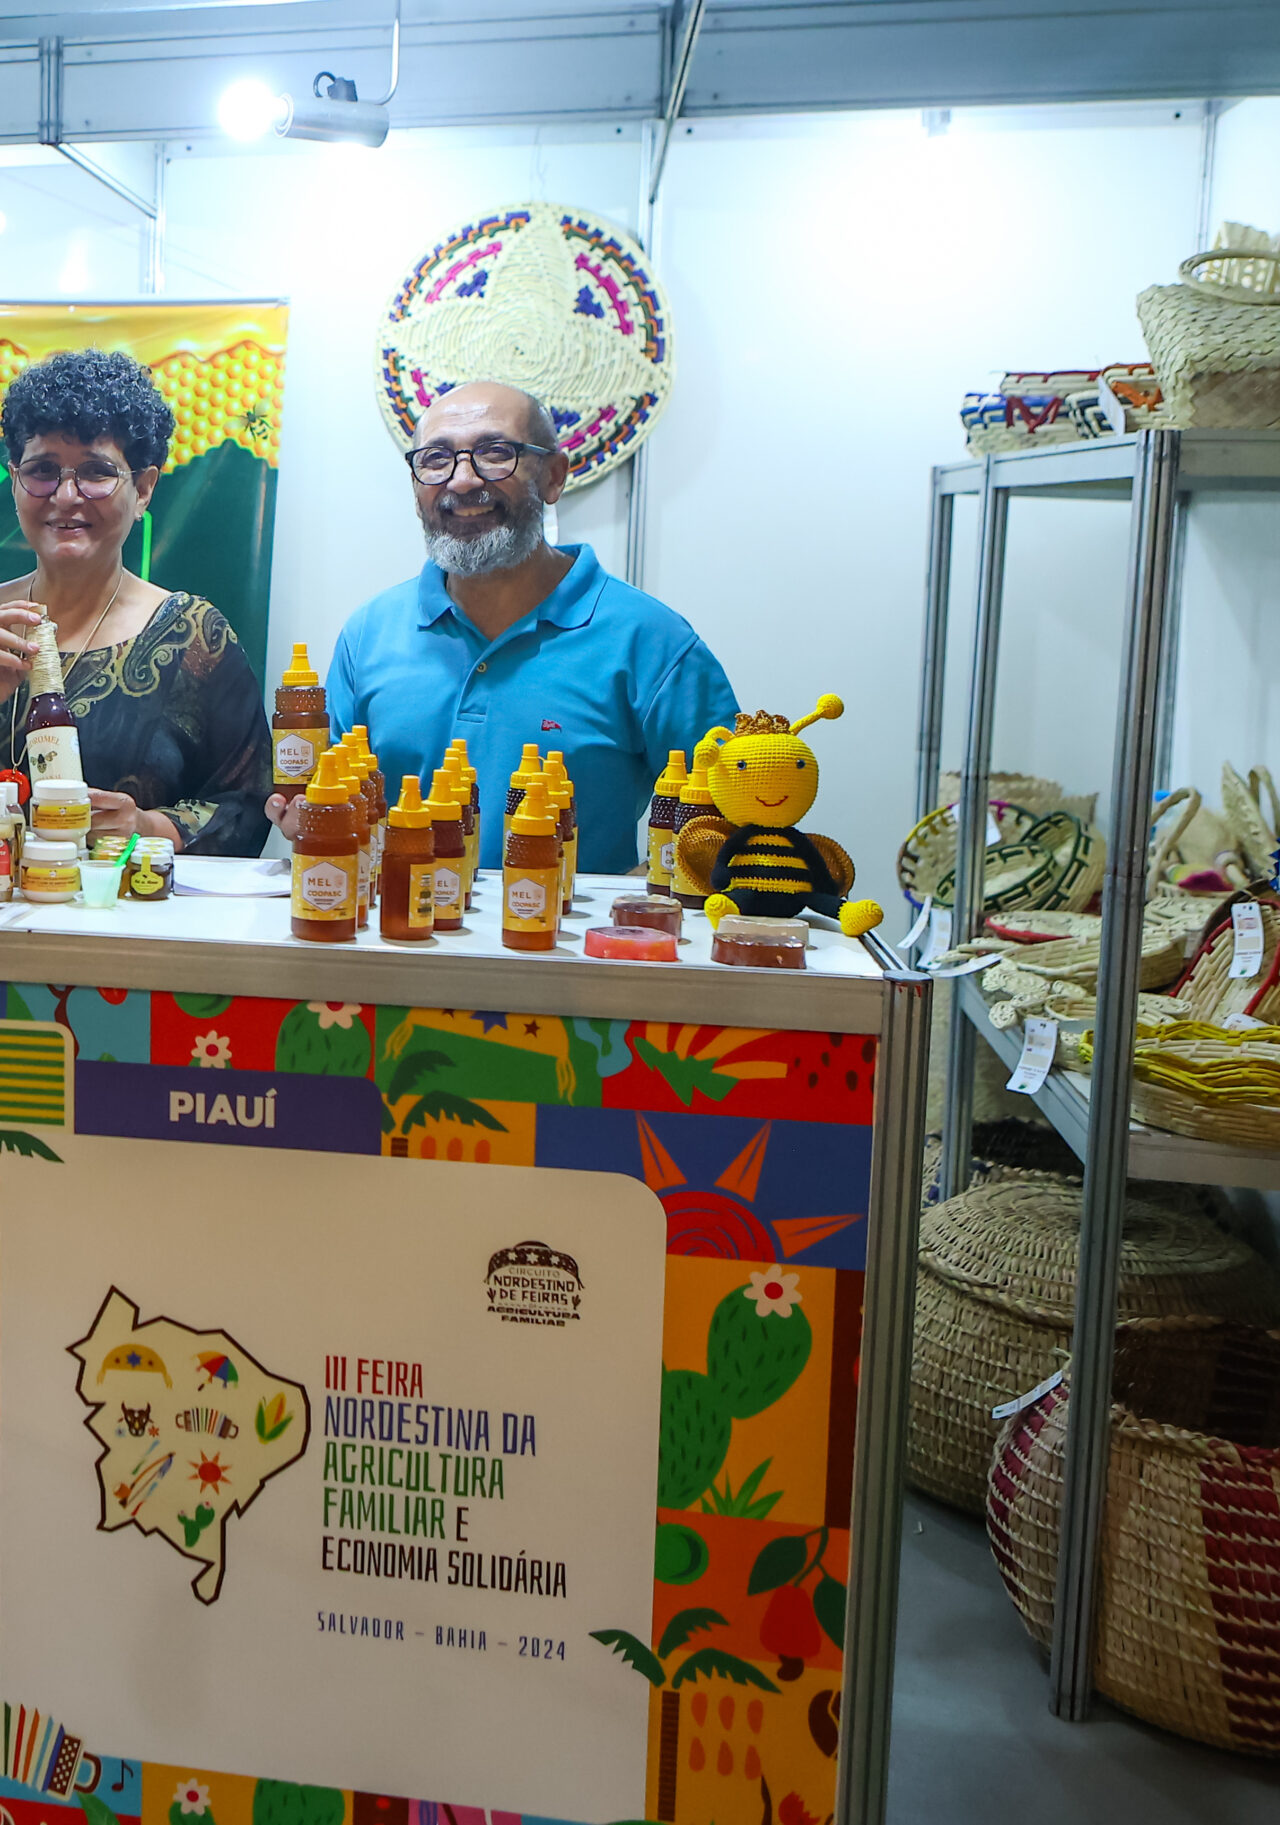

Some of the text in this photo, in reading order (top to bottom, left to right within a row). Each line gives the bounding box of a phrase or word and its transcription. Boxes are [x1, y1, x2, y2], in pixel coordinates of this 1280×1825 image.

[280, 748, 299, 756] MEL
[308, 877, 331, 887] MEL
[512, 891, 531, 899] MEL
[169, 1088, 278, 1128] PIAUÍ
[508, 1266, 561, 1278] CIRCUITO
[493, 1275, 575, 1293] NORDESTINO
[500, 1288, 569, 1306] DE FEIRAS
[487, 1306, 581, 1320] AGRICULTURA
[501, 1315, 566, 1327] FAMILIAR
[325, 1355, 423, 1399] III FEIRA
[324, 1396, 536, 1457] NORDESTINA DA
[323, 1441, 504, 1500] AGRICULTURA
[323, 1487, 469, 1542] FAMILIAR E
[322, 1536, 567, 1598] ECONOMIA SOLIDÁRIA
[318, 1611, 404, 1640] SALVADOR
[435, 1625, 487, 1650] BAHIA
[519, 1636, 565, 1661] 2024
